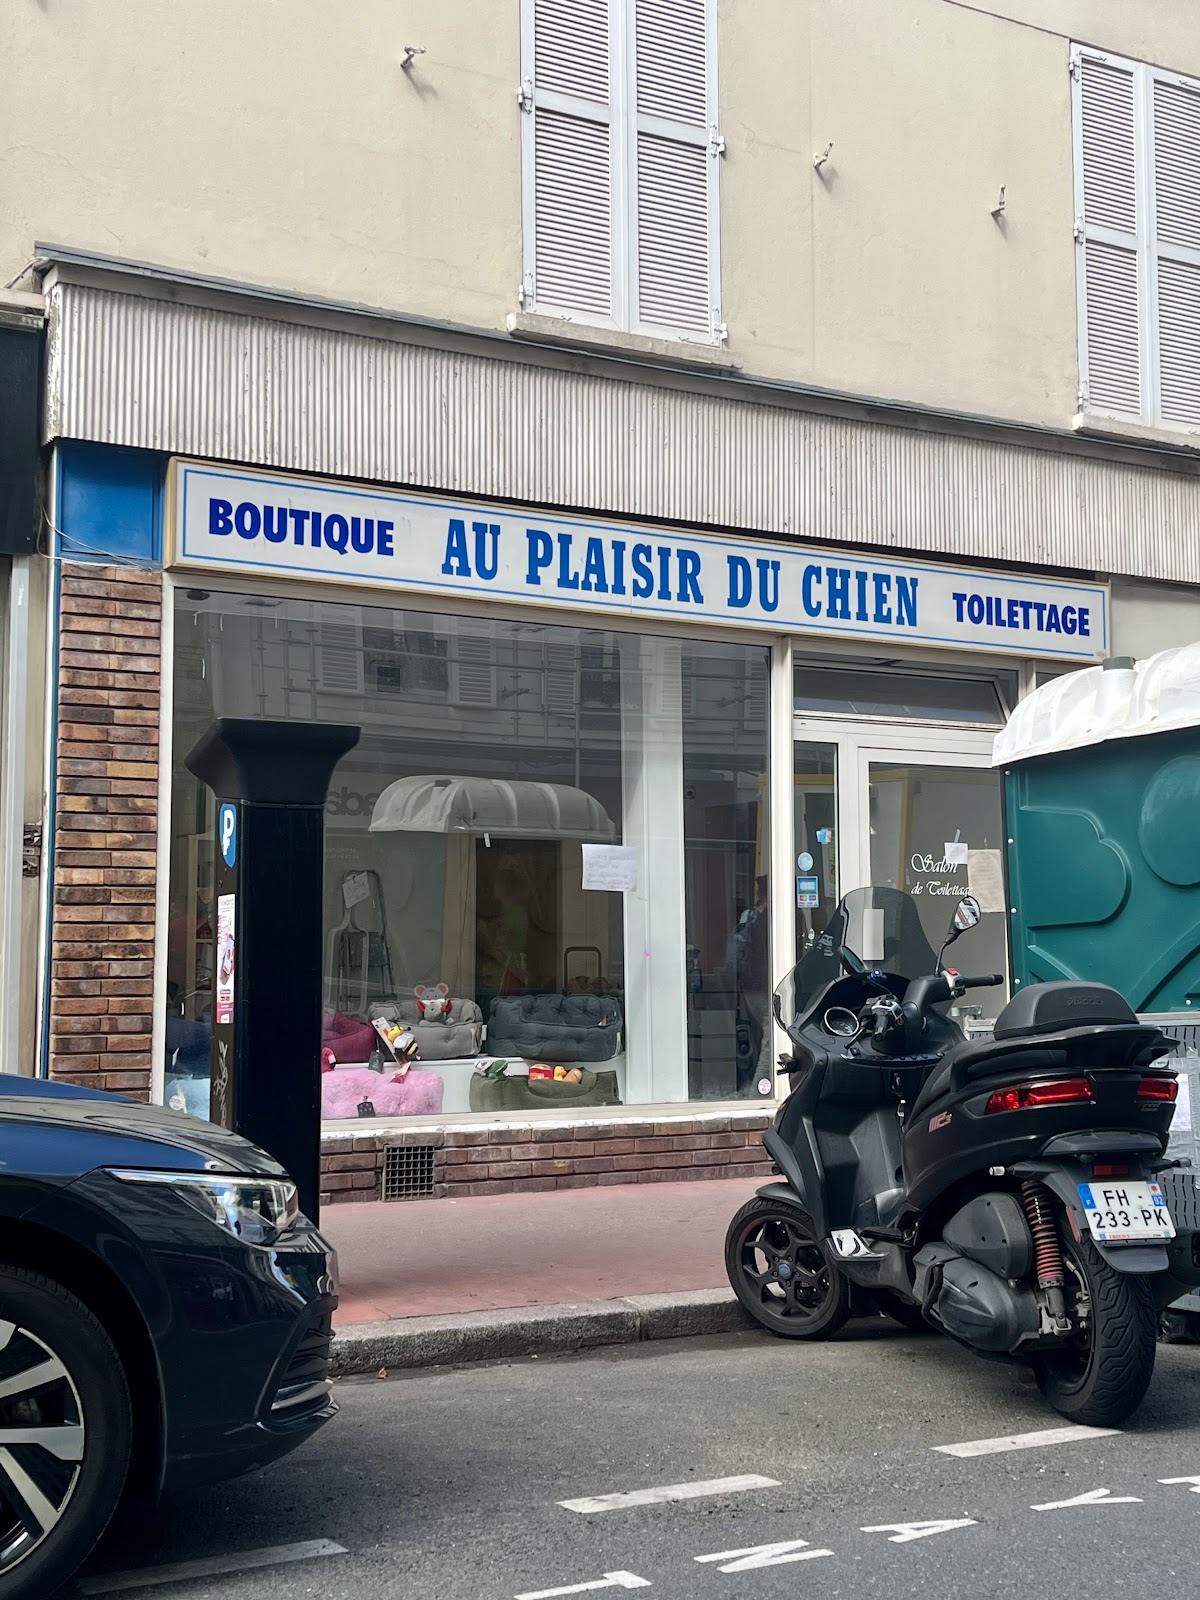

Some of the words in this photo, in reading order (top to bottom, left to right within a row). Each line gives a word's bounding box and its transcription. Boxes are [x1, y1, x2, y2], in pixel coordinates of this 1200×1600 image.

[209, 498, 394, 556] BOUTIQUE
[441, 518, 501, 581] AU
[526, 528, 704, 604] PLAISIR
[727, 554, 781, 612] DU
[802, 564, 919, 627] CHIEN
[952, 592, 1090, 636] TOILETTAGE
[911, 853, 958, 873] Salon
[910, 881, 924, 895] de
[926, 881, 974, 897] Toilettage
[1153, 1196, 1164, 1206] 92
[1093, 1208, 1168, 1229] 233-PK
